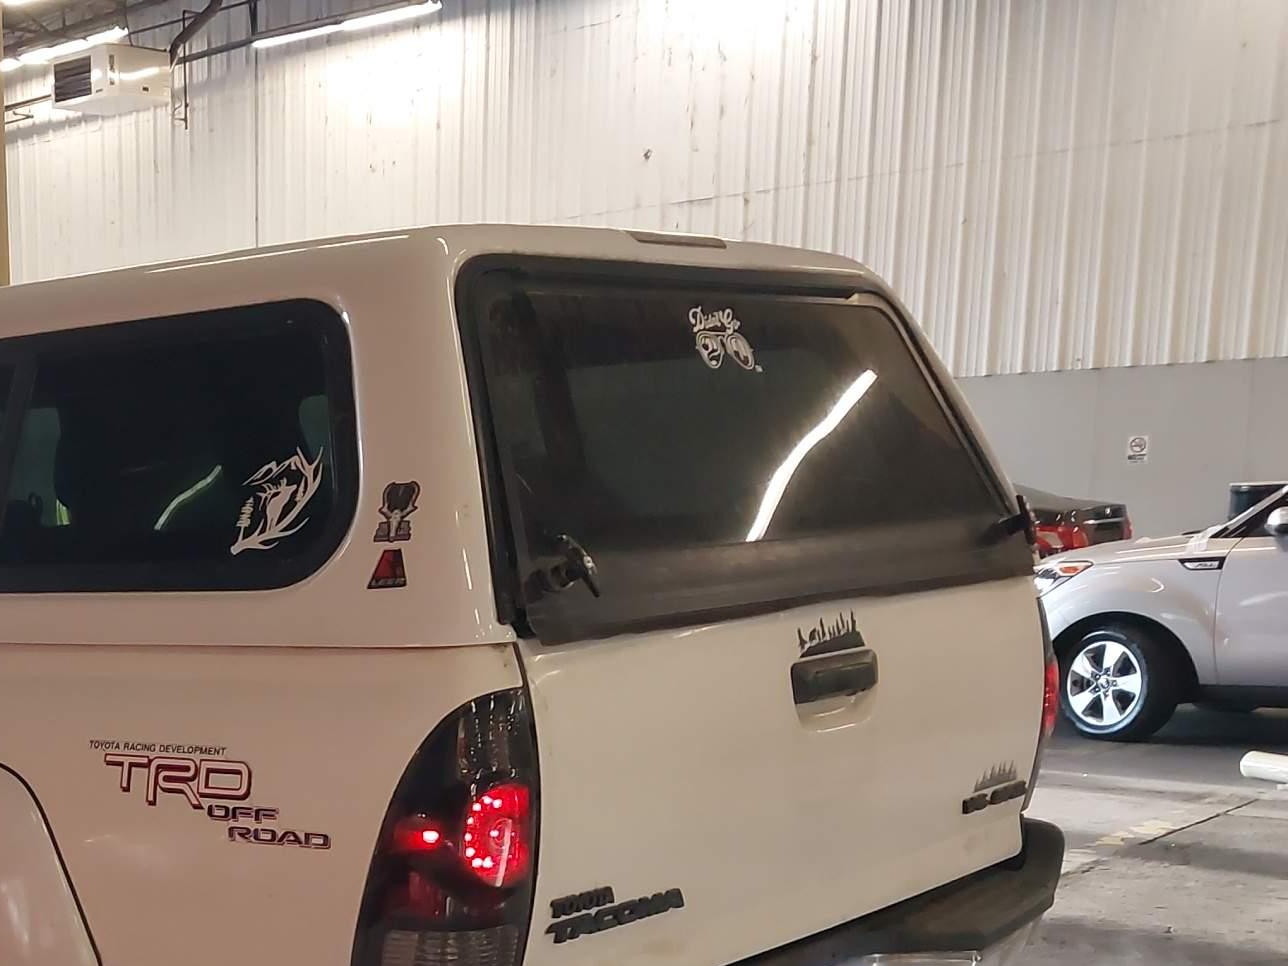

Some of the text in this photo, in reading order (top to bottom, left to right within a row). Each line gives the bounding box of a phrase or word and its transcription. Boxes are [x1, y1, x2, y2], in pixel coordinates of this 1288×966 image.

[89, 740, 227, 756] TOYOTA RACING DEVELOPMENT
[104, 753, 252, 810] TRD
[206, 804, 280, 823] OFF
[227, 826, 332, 850] ROAD
